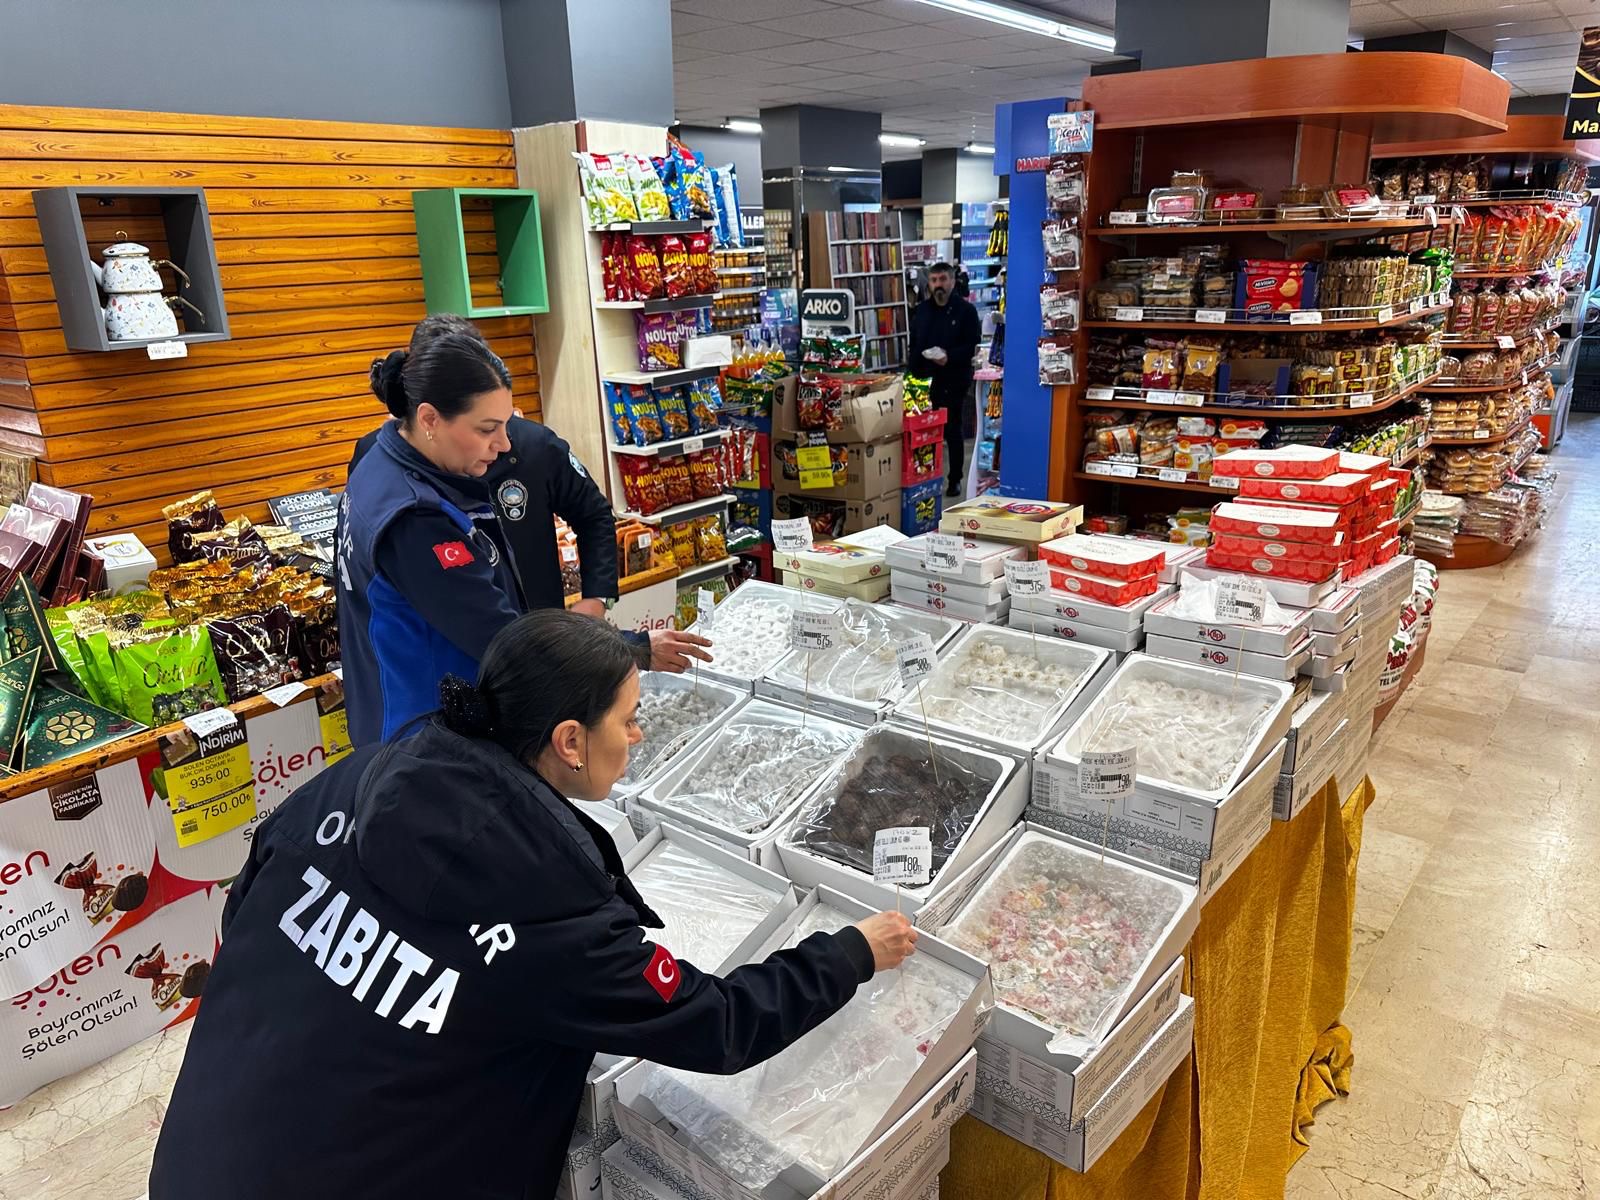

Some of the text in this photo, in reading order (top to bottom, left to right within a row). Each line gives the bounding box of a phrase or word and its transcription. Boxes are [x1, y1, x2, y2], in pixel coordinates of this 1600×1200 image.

[804, 298, 842, 315] ARKO
[199, 728, 245, 758] İNDİRİM
[189, 767, 230, 789] 935.00
[249, 746, 326, 787] ölen
[53, 788, 99, 810] ÇİKOLATA
[59, 797, 96, 813] FABRİKASI
[17, 909, 71, 949] Olsun!
[278, 865, 461, 1035] ZABITA
[21, 995, 138, 1060] Şölen Olsun!
[28, 988, 124, 1040] Bayramınız
